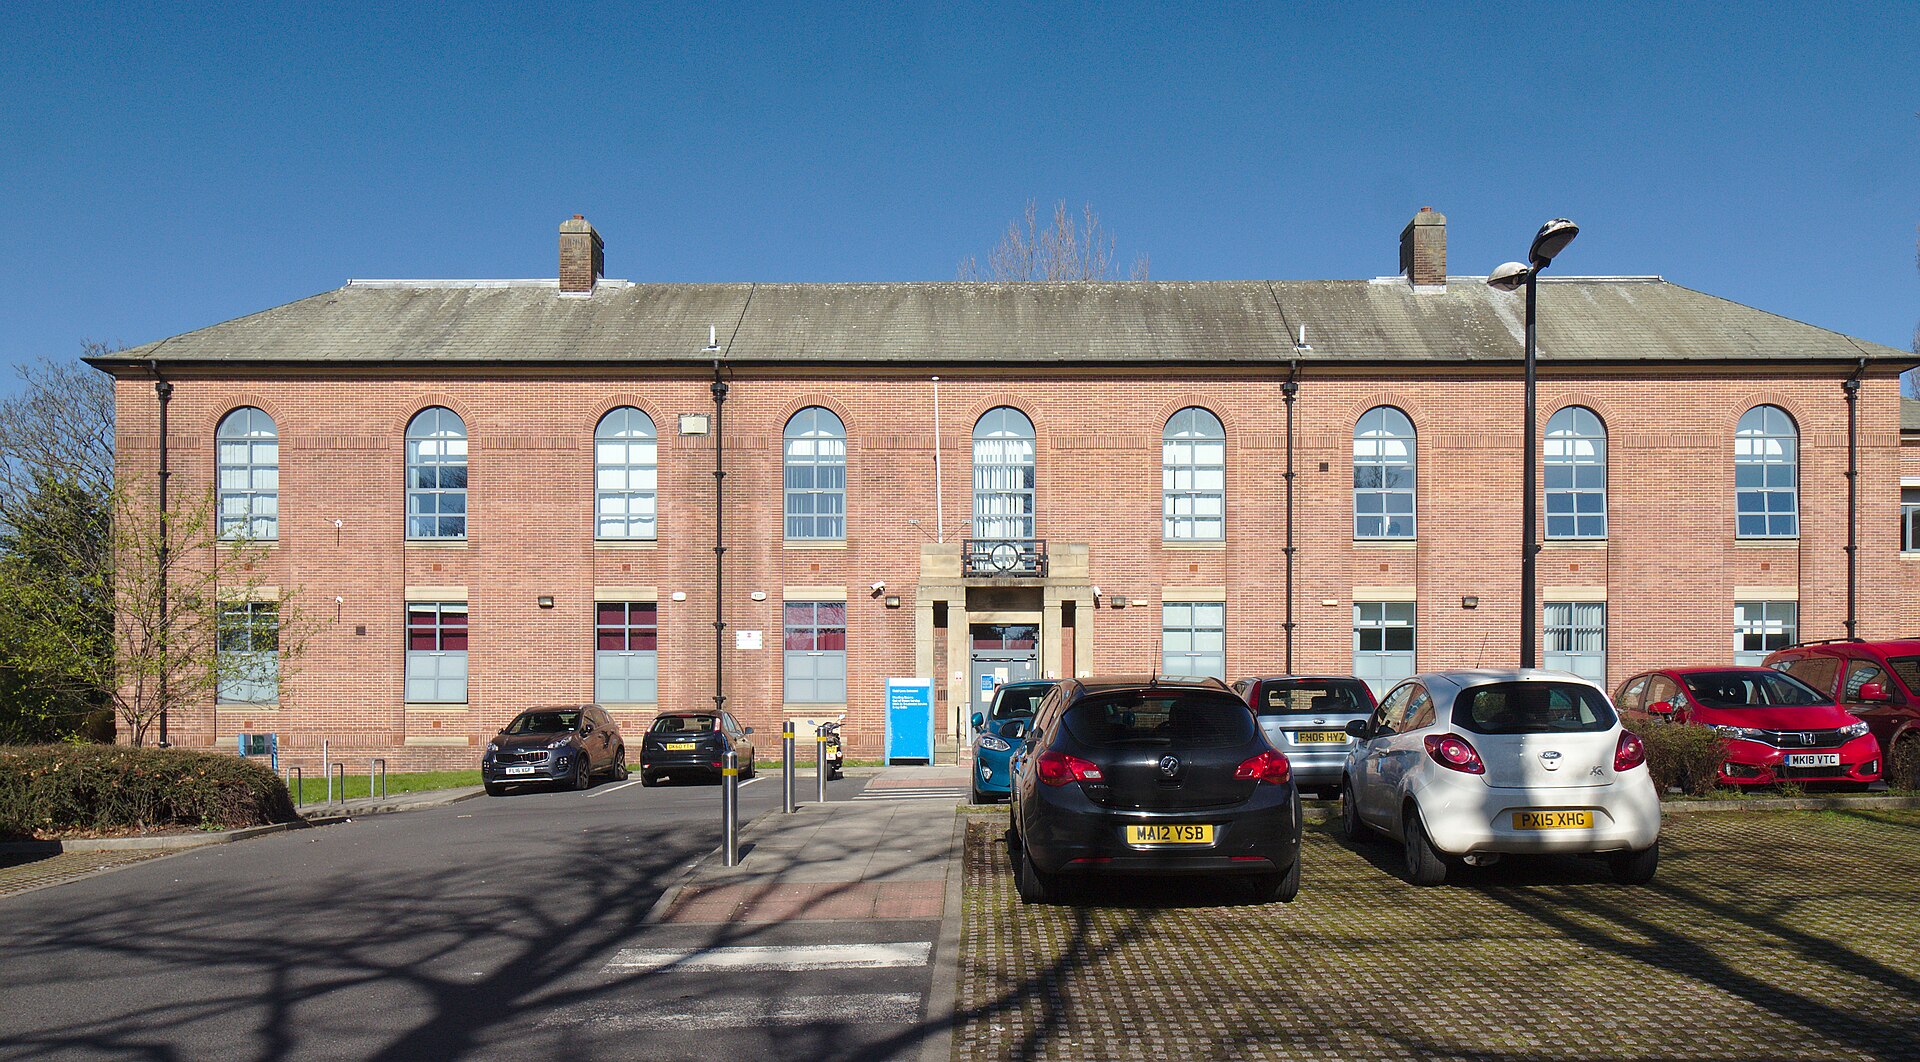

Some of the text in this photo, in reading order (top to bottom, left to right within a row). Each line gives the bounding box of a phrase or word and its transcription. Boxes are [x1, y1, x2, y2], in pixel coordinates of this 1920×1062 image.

[1300, 732, 1346, 742] FH06 HYZ
[1792, 754, 1836, 765] MK18 VTC
[1522, 813, 1585, 827] PX15 XHG
[1137, 826, 1204, 841] MA12 YSB
